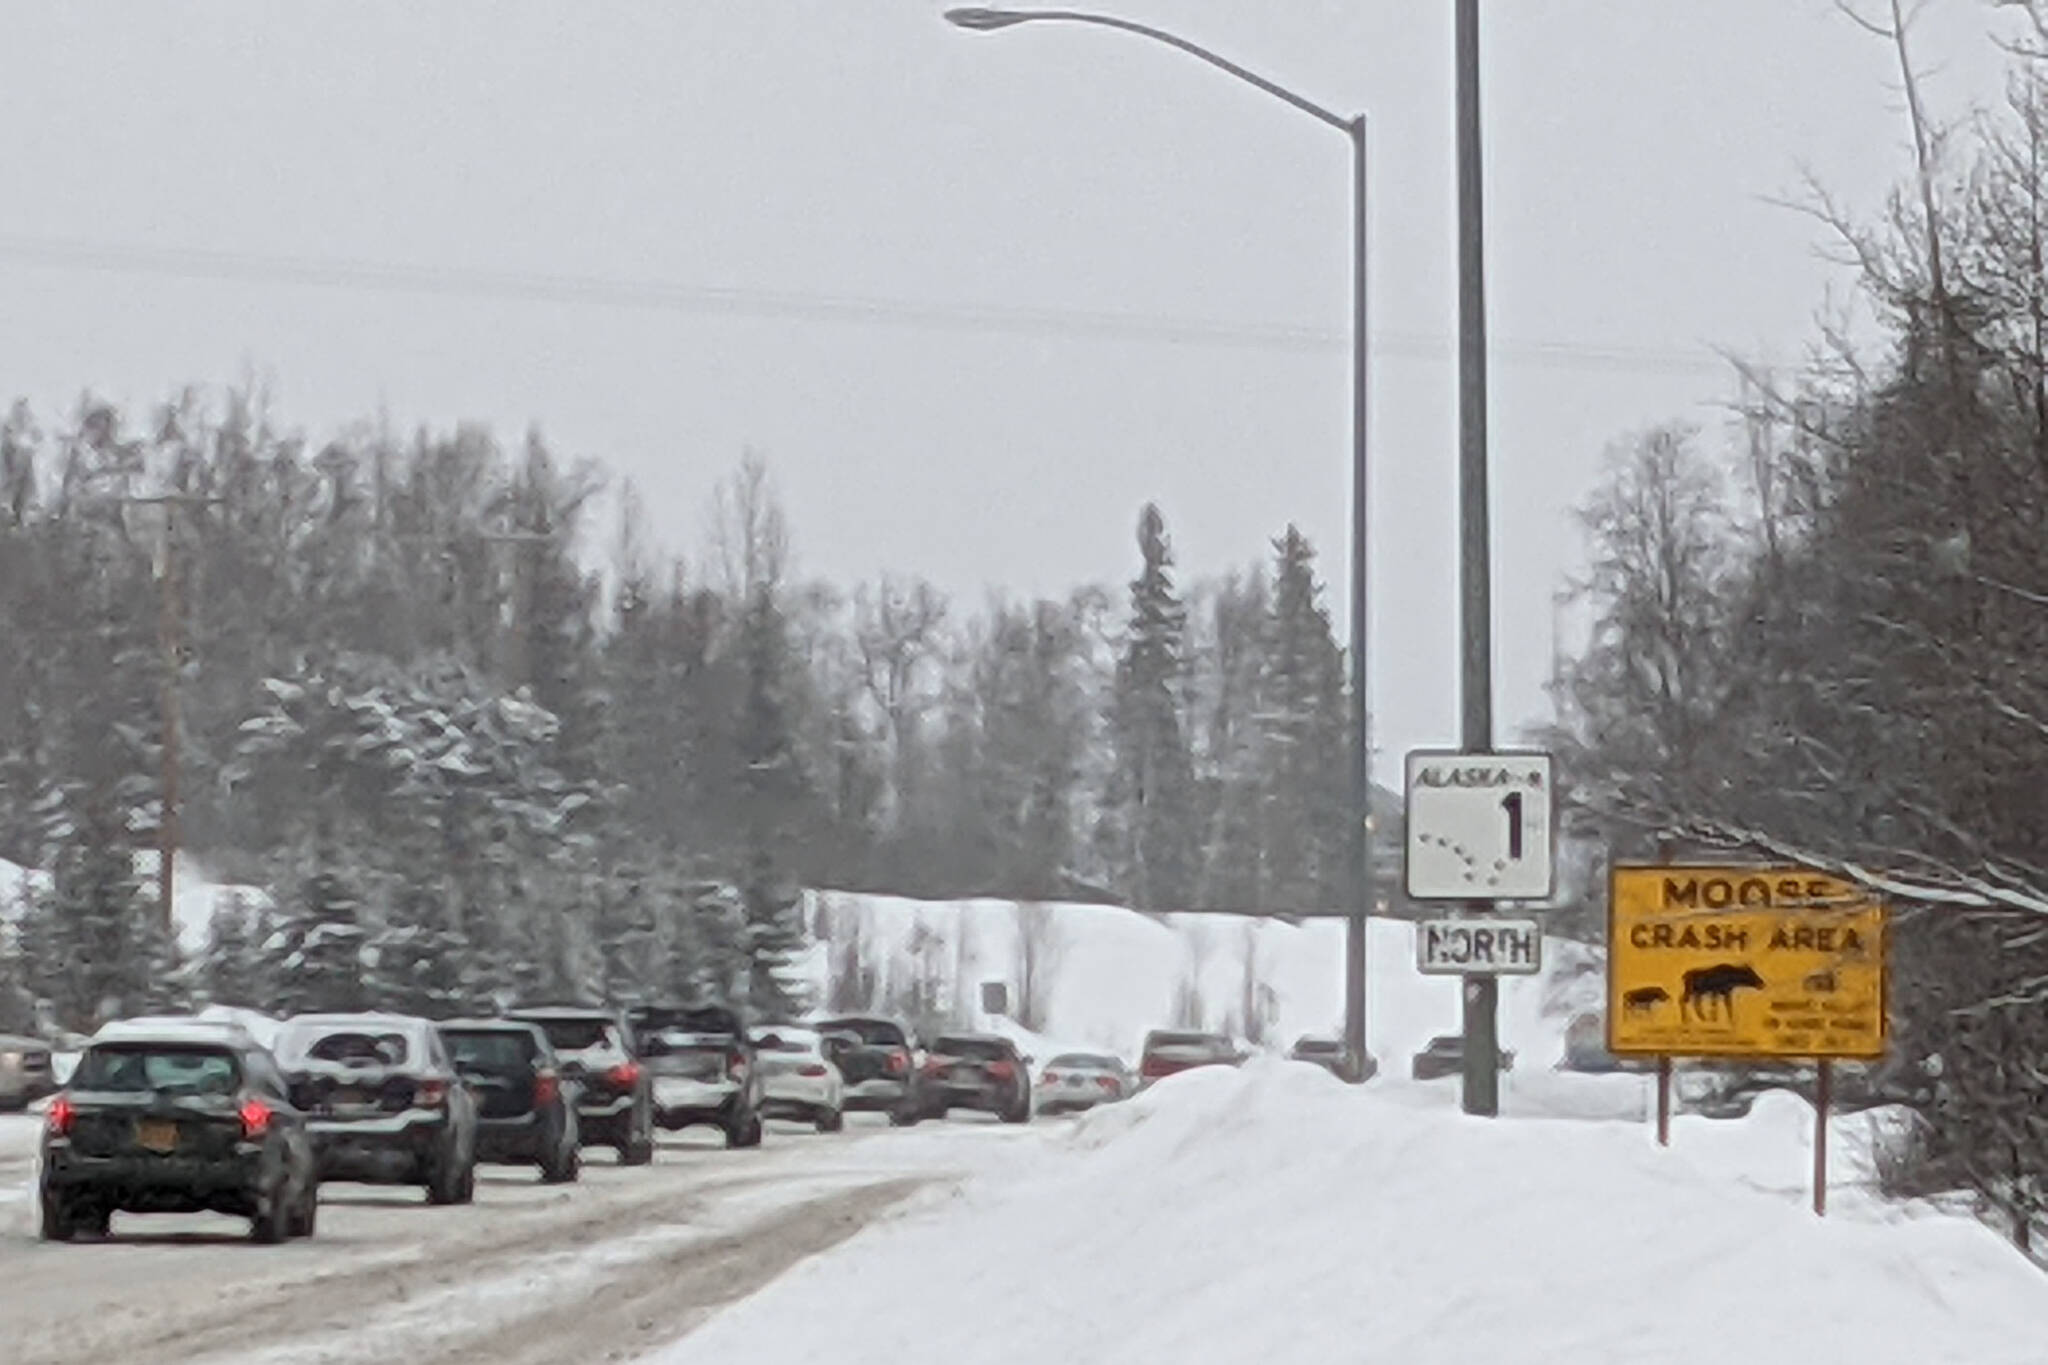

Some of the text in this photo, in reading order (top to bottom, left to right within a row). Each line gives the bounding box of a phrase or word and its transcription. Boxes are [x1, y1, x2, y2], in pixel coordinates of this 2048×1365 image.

[1413, 767, 1510, 788] ALASKA
[1501, 791, 1522, 860] 1
[1427, 925, 1530, 963] NORTH
[1630, 923, 1862, 952] CRASH AREA
